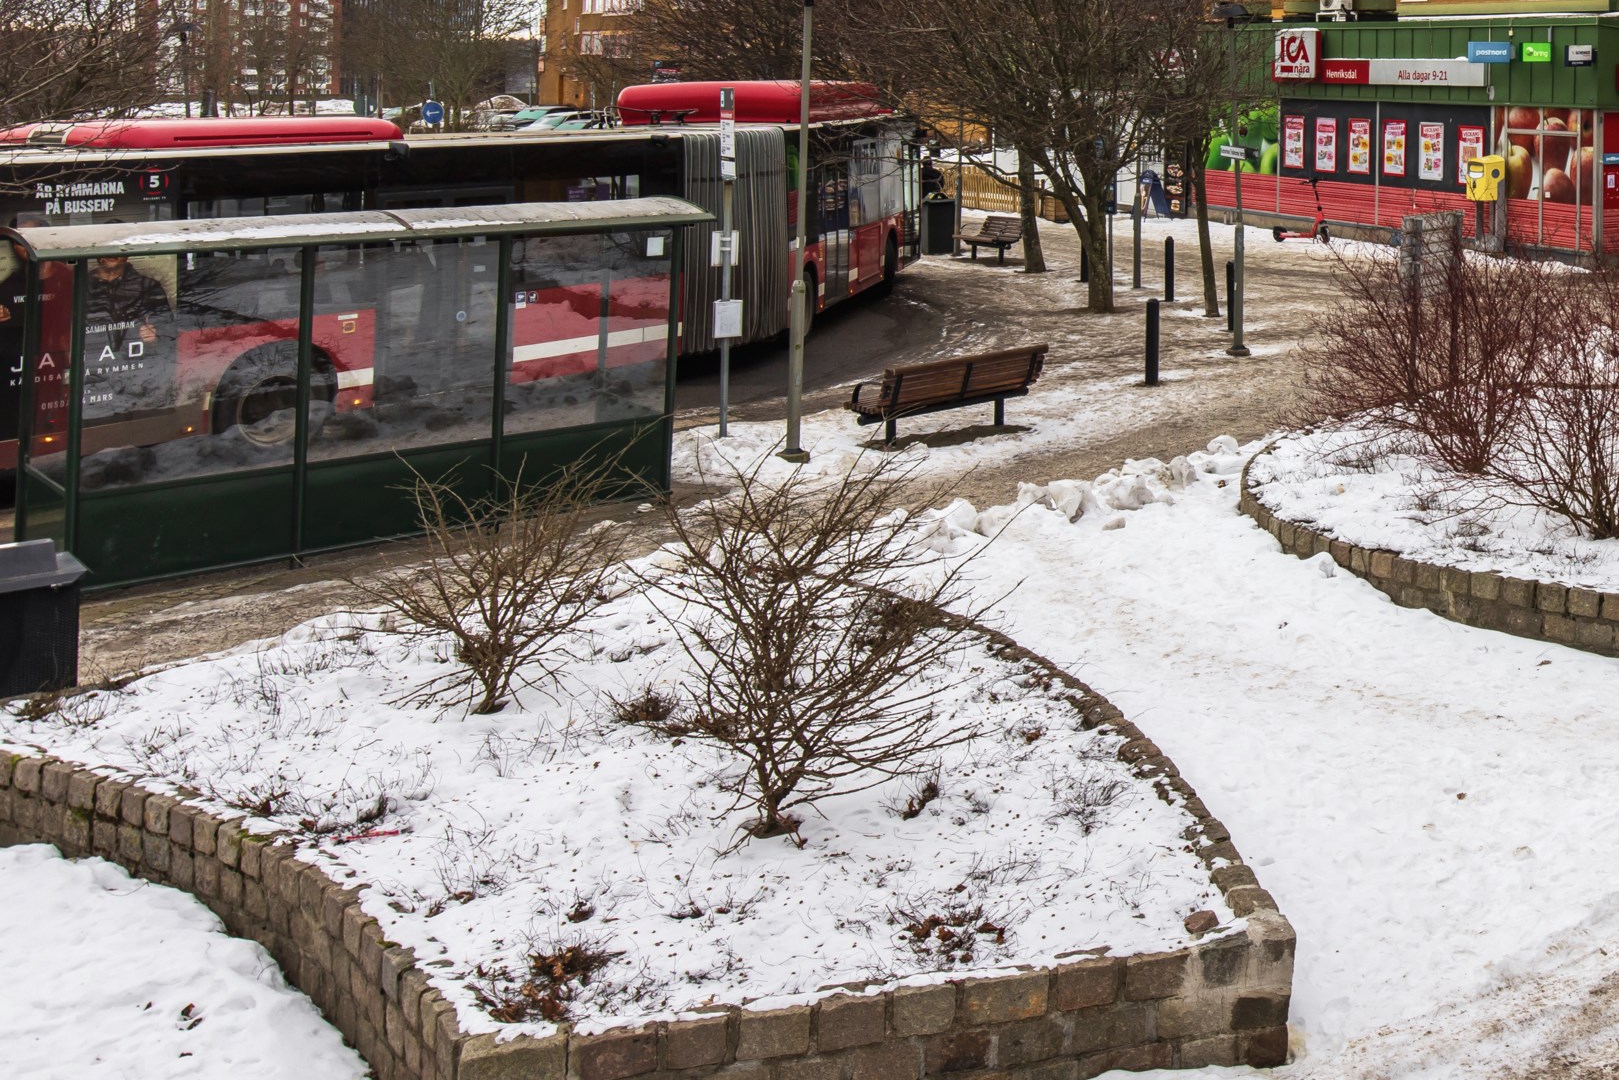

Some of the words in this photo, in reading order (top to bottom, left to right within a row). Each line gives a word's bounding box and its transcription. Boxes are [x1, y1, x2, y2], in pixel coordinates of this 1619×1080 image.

[1280, 35, 1309, 63] ICA
[1533, 49, 1548, 58] bring
[1293, 64, 1310, 73] nära
[1326, 69, 1357, 79] Henriksdal
[1398, 70, 1411, 80] Alla
[1412, 71, 1431, 85] dagar
[1432, 71, 1447, 81] 9-21
[149, 175, 160, 188] 5
[35, 183, 53, 199] ÄR
[55, 182, 125, 198] RYMMARNA
[45, 198, 61, 215] PÅ
[64, 198, 115, 214] BUSSEN?
[85, 324, 107, 334] SAMIR
[107, 321, 135, 332] BADRAN
[97, 363, 144, 375] RYMMEN
[90, 393, 113, 403] MARS
